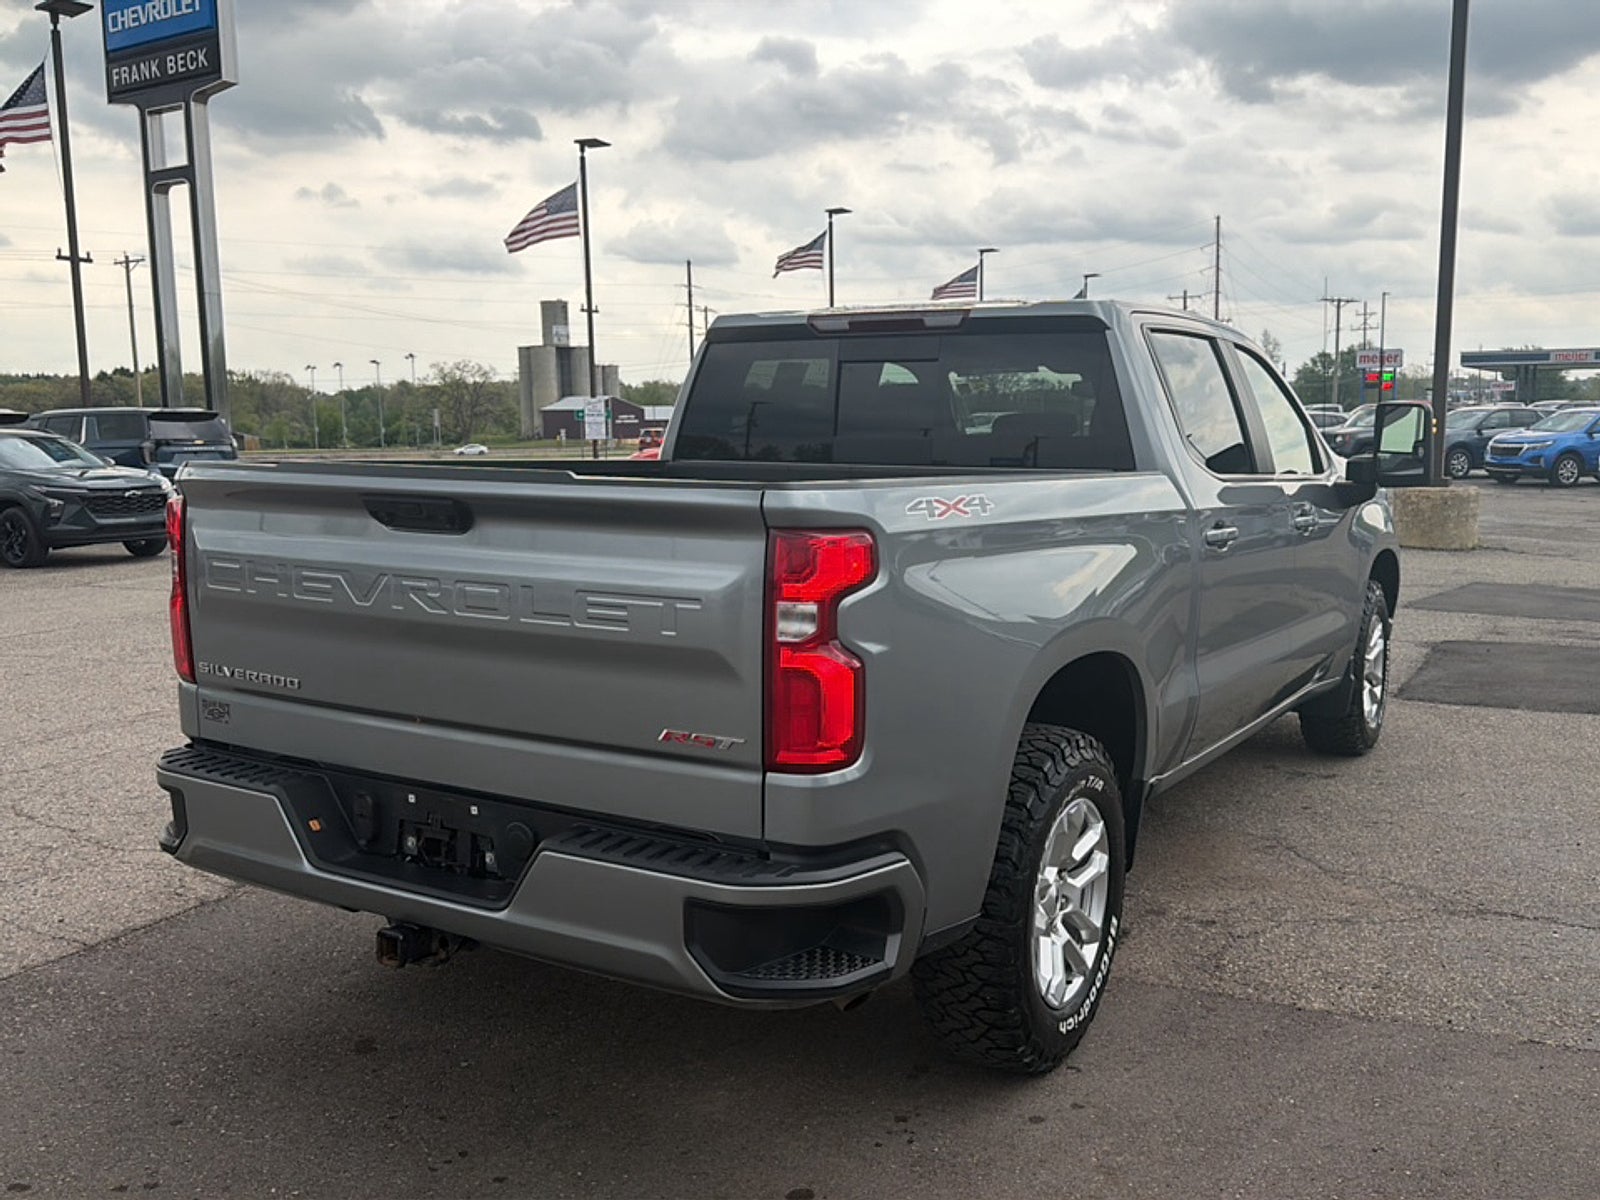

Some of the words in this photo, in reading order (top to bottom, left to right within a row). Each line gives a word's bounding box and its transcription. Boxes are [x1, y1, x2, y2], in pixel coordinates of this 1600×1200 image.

[112, 58, 161, 88] FRANK
[166, 47, 209, 75] BECK
[205, 557, 704, 637] CHEVROLET
[198, 661, 301, 690] SILVERADO
[657, 728, 747, 750] RST
